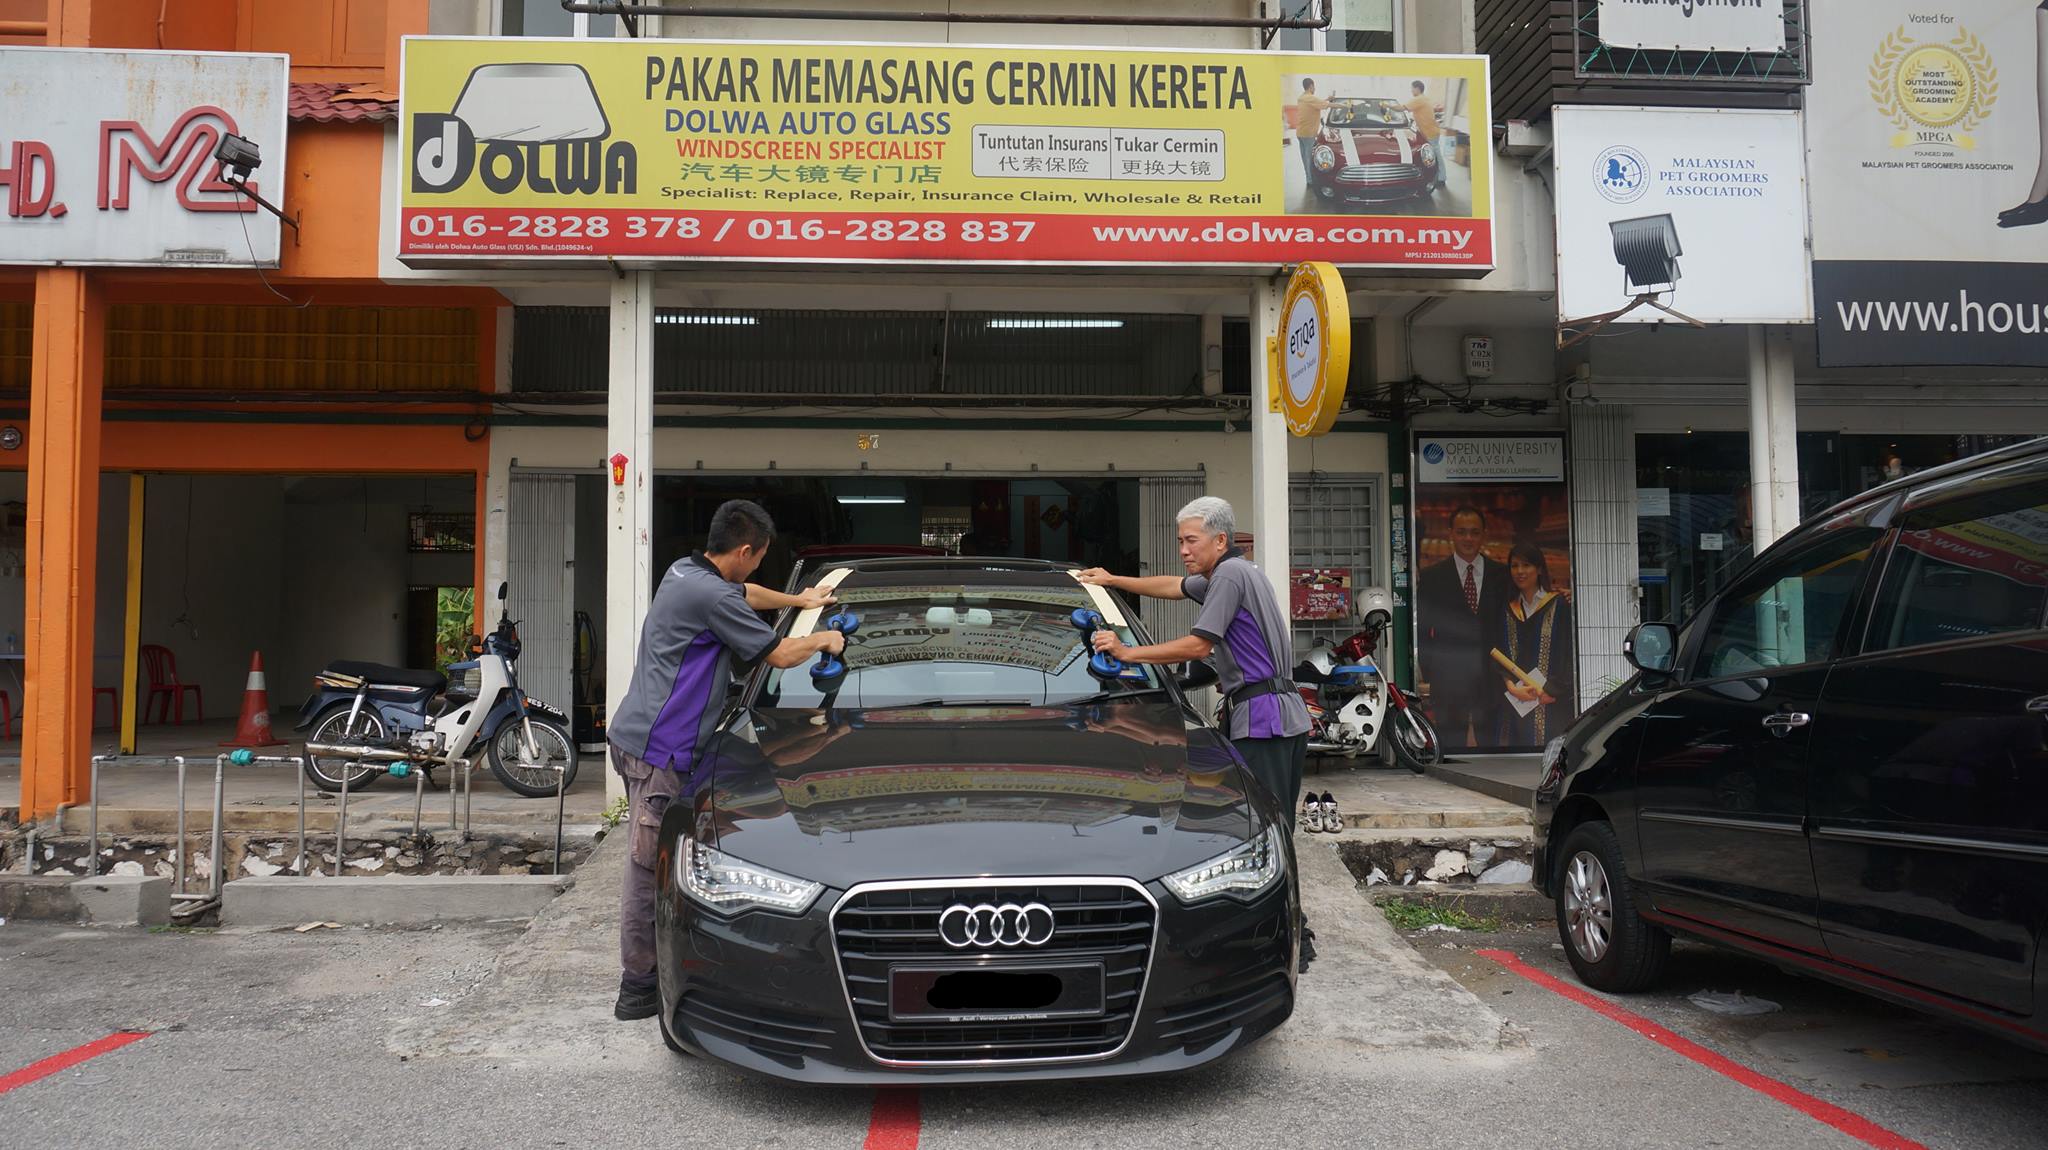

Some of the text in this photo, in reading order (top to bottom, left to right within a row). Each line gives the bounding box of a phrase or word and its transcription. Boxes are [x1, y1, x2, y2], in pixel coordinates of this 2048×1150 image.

[1908, 13, 1955, 24] Voted for
[645, 55, 1252, 110] PAKAR MEMASANG CERMIN KERETA
[1905, 79, 1964, 87] OUTSTANDING
[664, 108, 951, 136] DOLWA AUTO GLASS
[978, 132, 1108, 153] Tuntutan Insurans
[1916, 131, 1954, 143] MPGA
[675, 138, 946, 161] WINDSCREEN SPECIALIST
[1114, 136, 1219, 154] Tukar Cermin
[998, 155, 1090, 173] 代索保险
[1121, 158, 1212, 177] 更换大镜
[1672, 157, 1755, 169] MALAYSIAN
[1861, 161, 1905, 169] MALAYSIAN
[1921, 162, 1964, 170] GROOMERS
[1964, 163, 2014, 171] ASSOCIATION
[680, 161, 943, 184] 汽车大镜专门店
[1659, 171, 1769, 183] PET GROOMERS
[661, 186, 1262, 205] Specialist: Replace, Repair, Insurance Claim, Wholesale & Retail
[1665, 186, 1763, 197] ASSOCIATION
[409, 214, 1473, 250] 016-2828 378 / 016-2828 837 www.dolwa.com.my
[507, 244, 524, 252] (USJ)
[1836, 289, 2048, 334] www.hou
[1446, 442, 1557, 455] OPEN UNIVERSITY
[1446, 455, 1515, 465] MALAYSIA
[1447, 467, 1472, 475] SCHOOL
[1472, 467, 1480, 475] OF
[1480, 467, 1510, 475] LIFELONG
[543, 702, 563, 716] 7204
